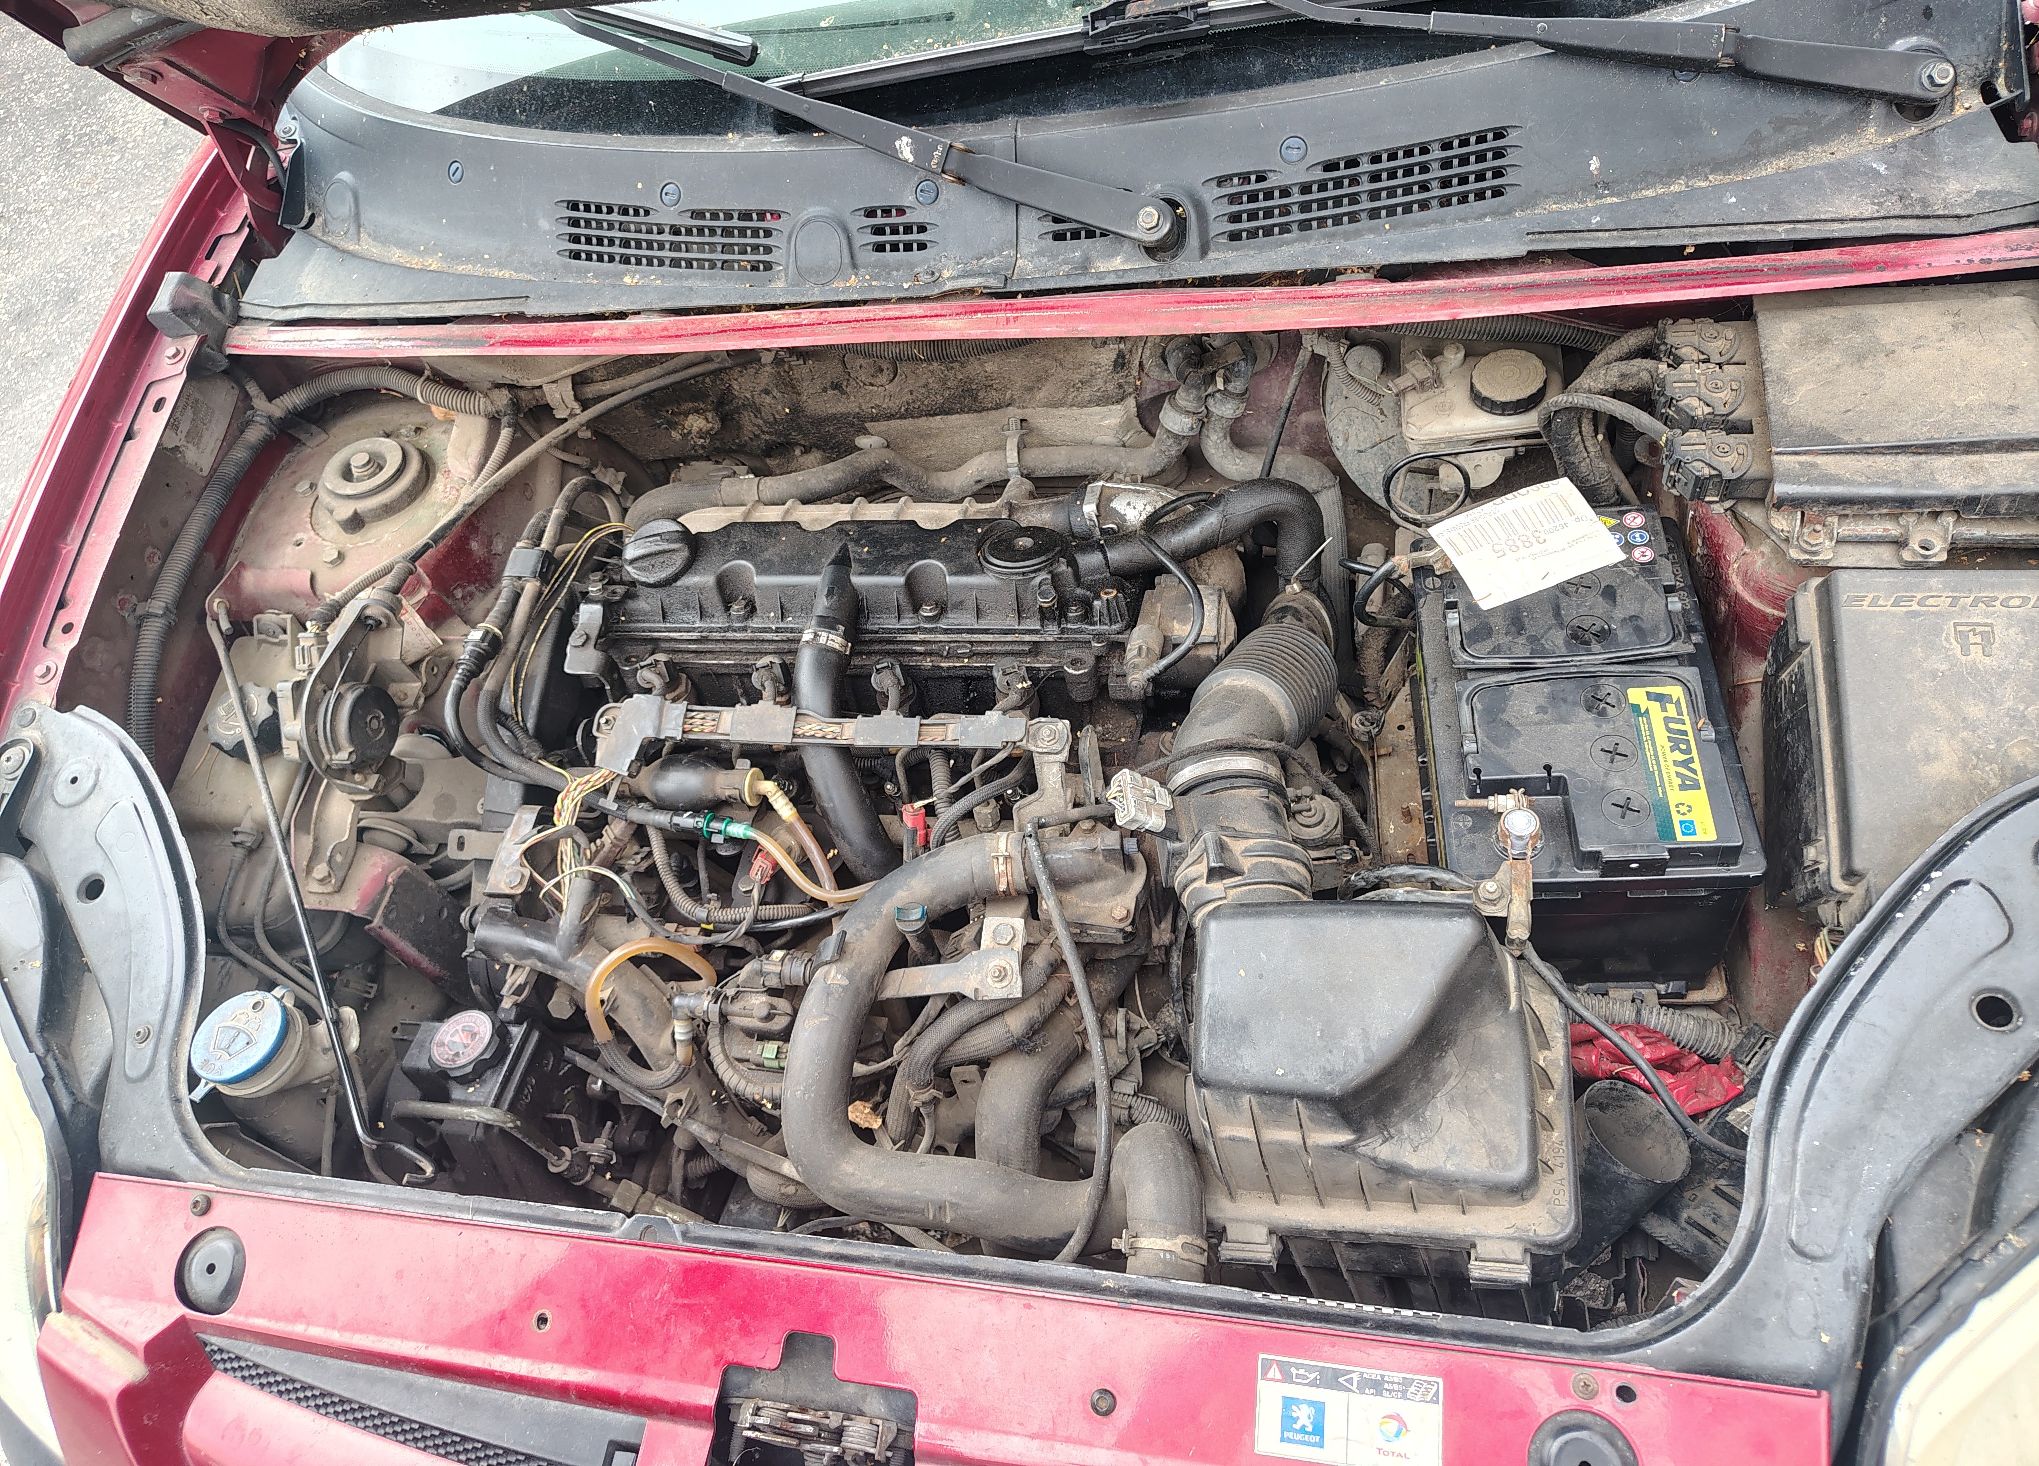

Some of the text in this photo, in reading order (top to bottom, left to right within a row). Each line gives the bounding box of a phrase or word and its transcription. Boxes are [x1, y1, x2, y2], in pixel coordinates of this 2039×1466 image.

[1842, 594, 2039, 609] ELECTRO
[1646, 691, 1701, 791] FURYA
[1552, 1140, 1566, 1207] PSA 4194
[1283, 1431, 1321, 1443] PEUGEOT
[1376, 1447, 1411, 1460] TOTAL
